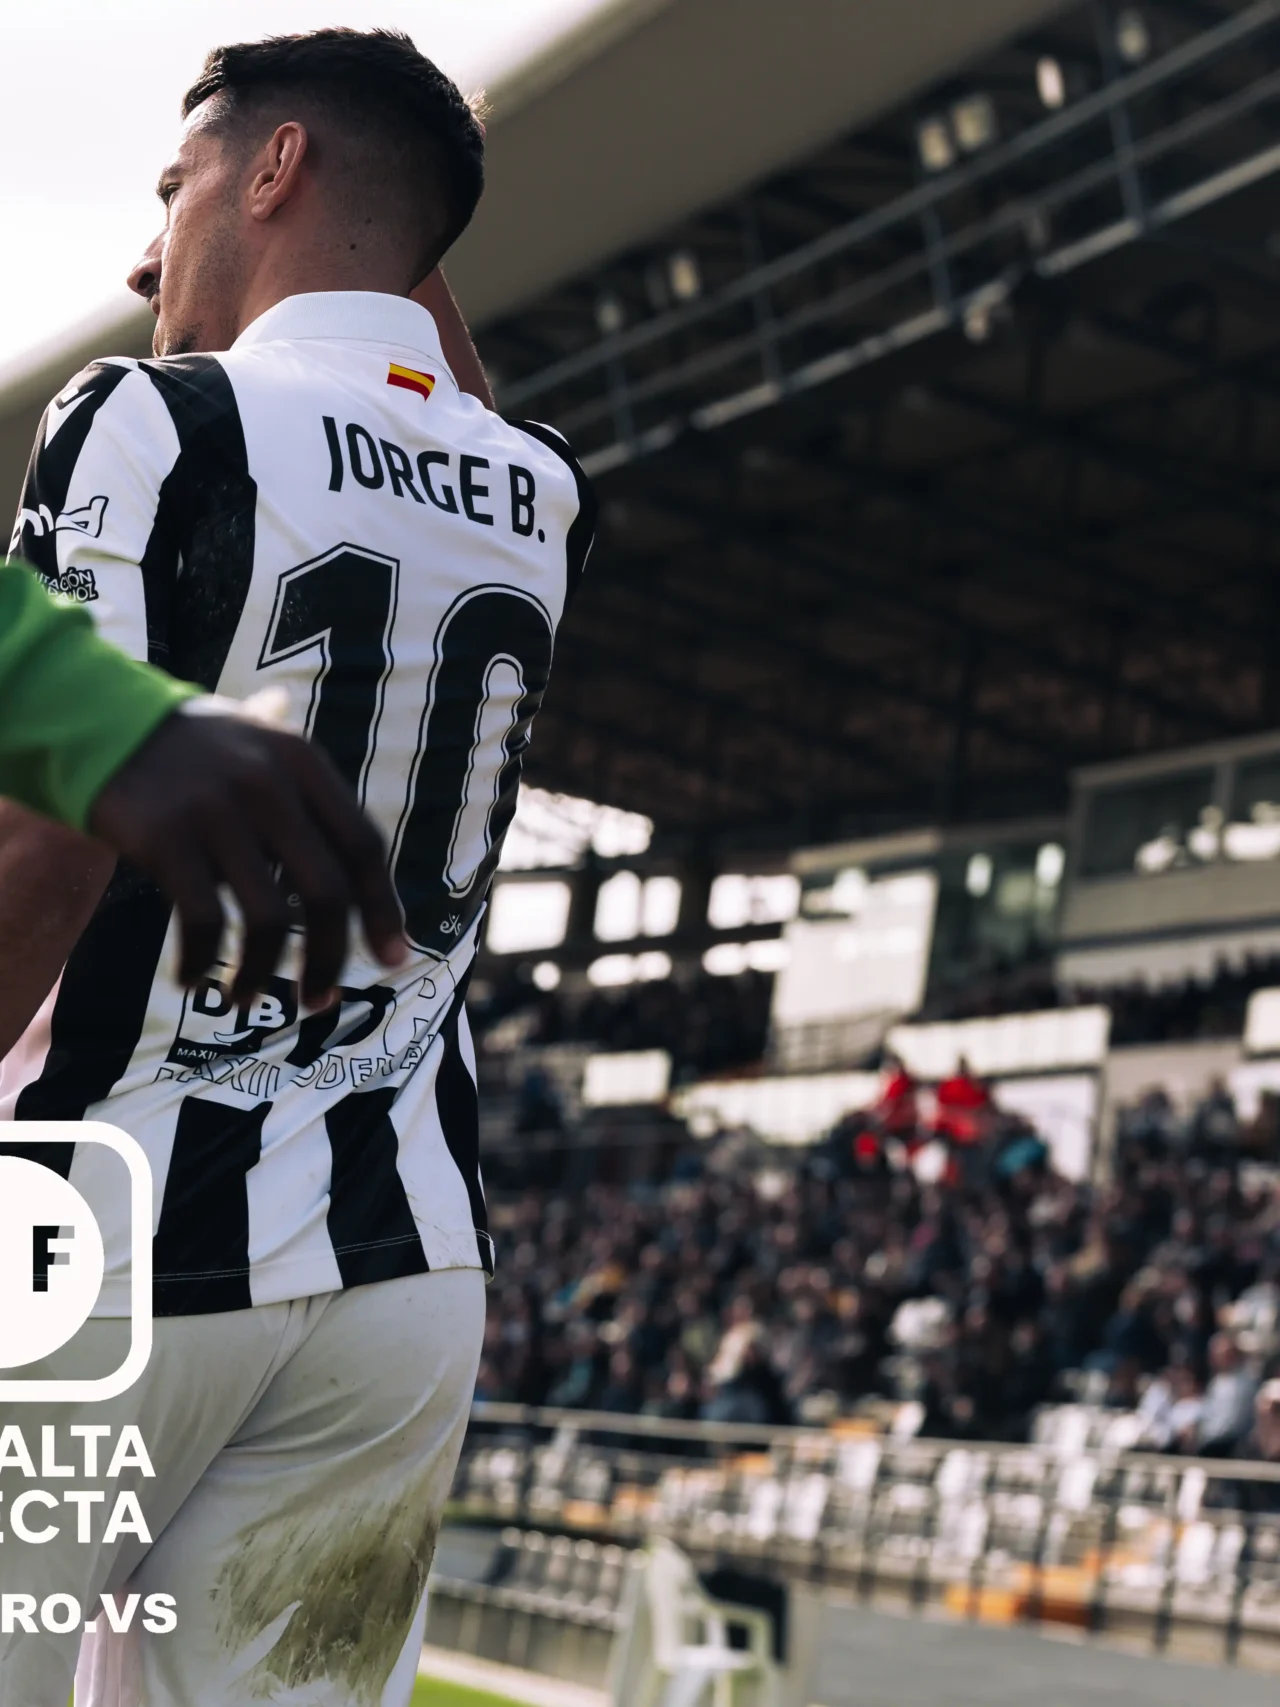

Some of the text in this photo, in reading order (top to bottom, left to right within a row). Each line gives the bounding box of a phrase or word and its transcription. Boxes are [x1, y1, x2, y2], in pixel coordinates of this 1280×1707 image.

[322, 415, 547, 544] JORGE B.
[256, 541, 554, 957] 10
